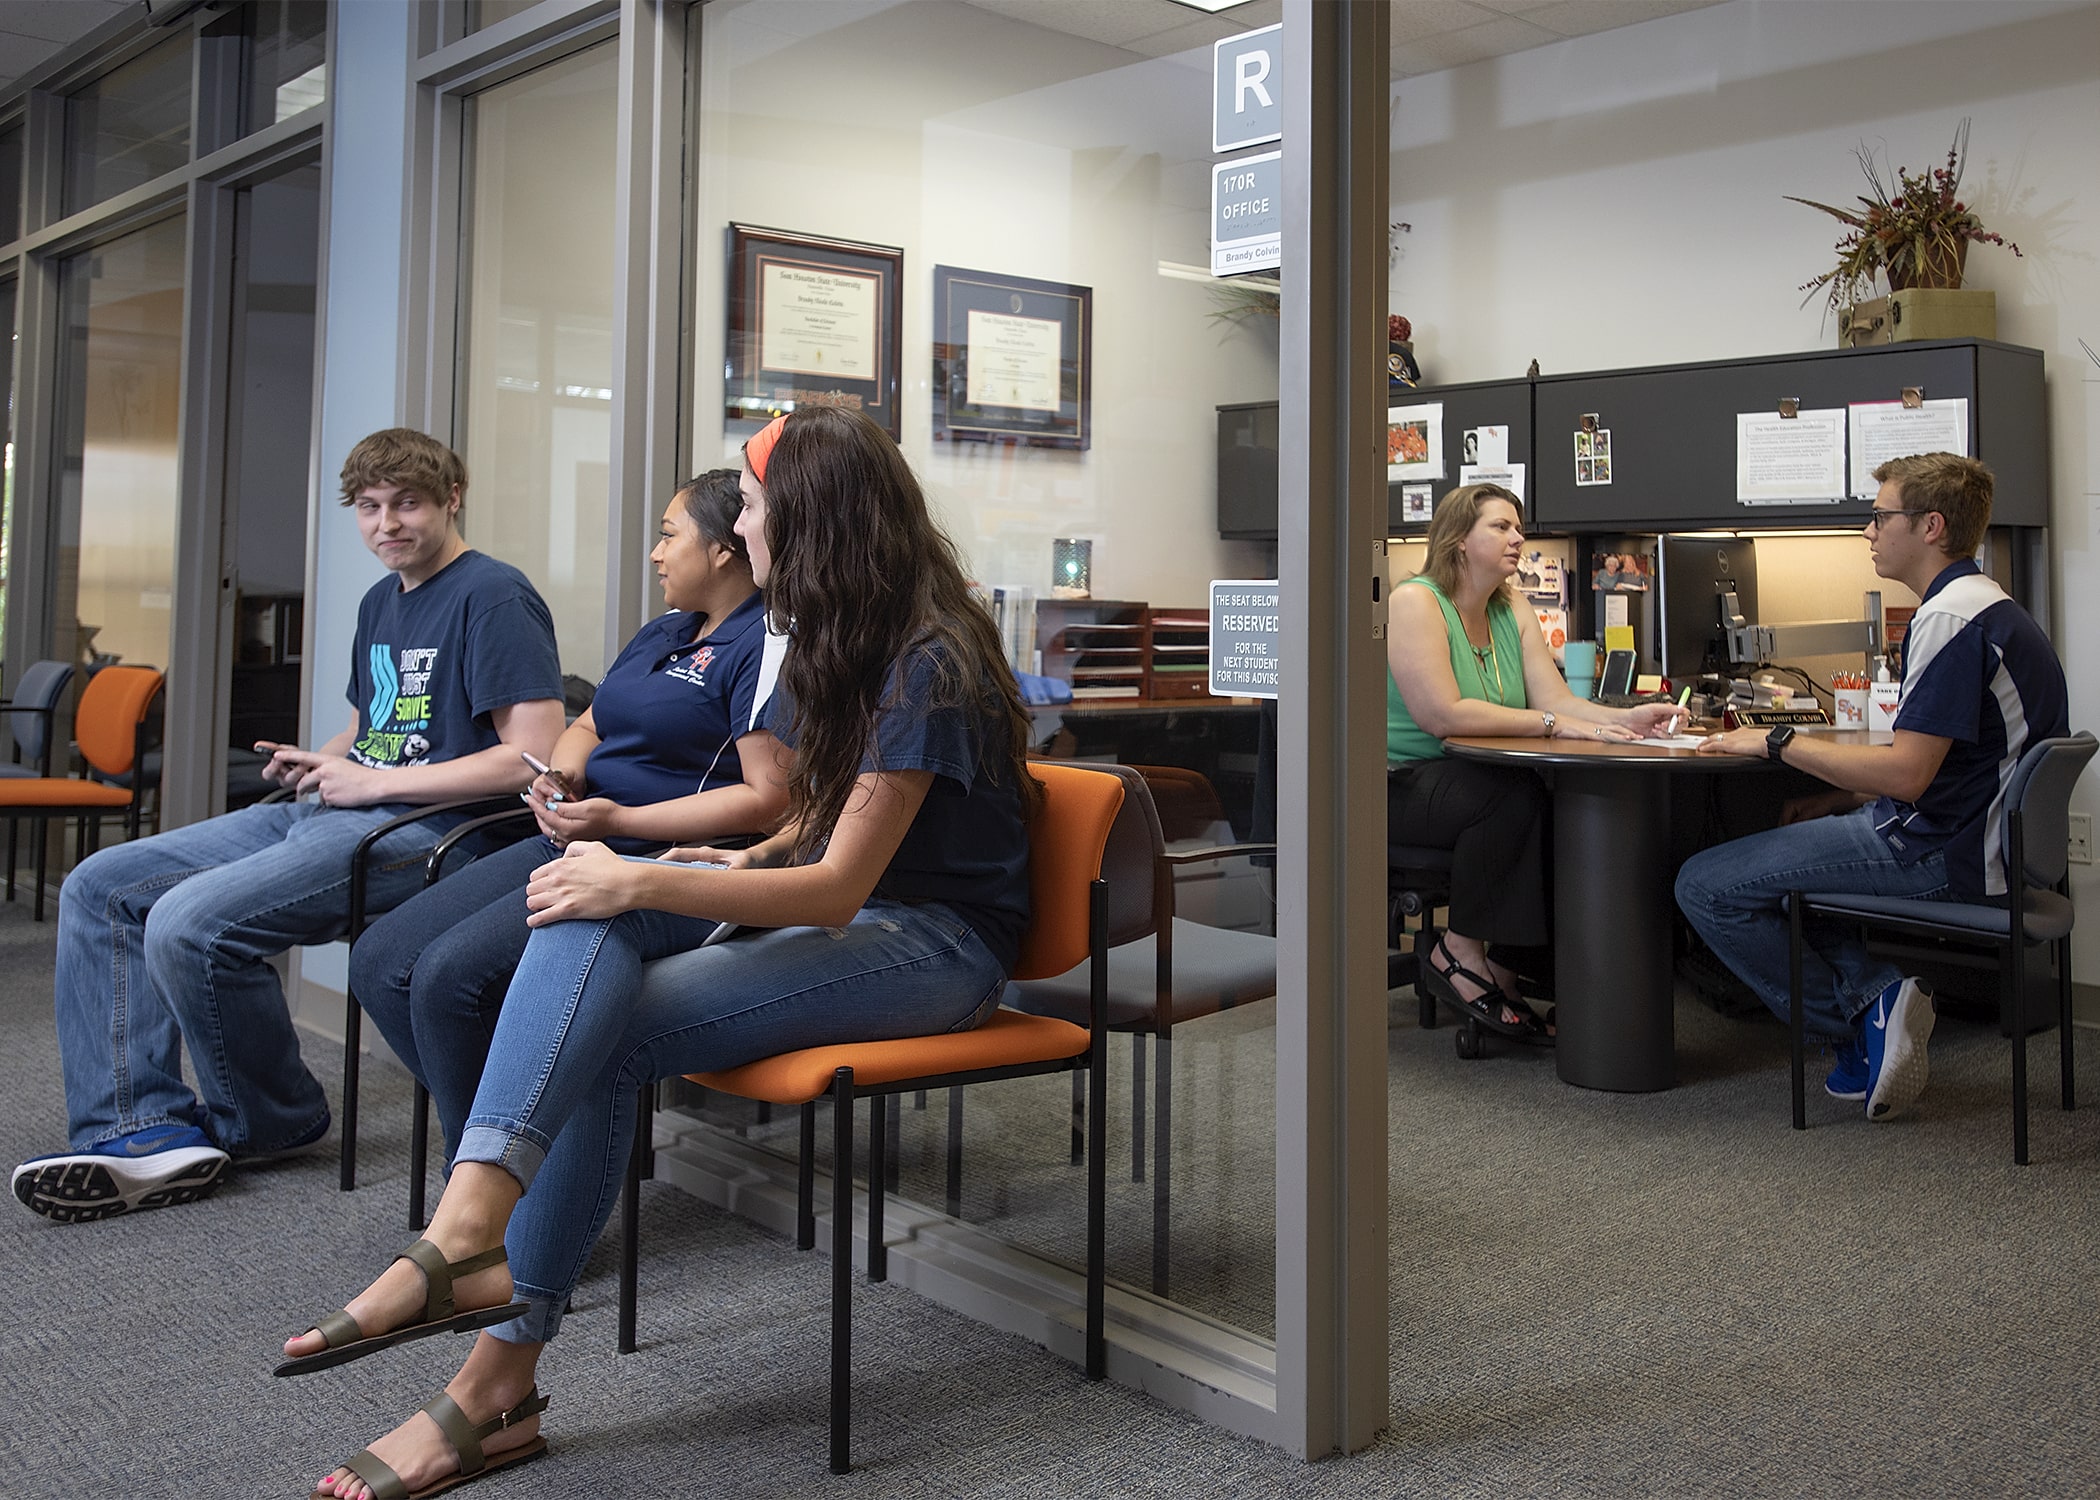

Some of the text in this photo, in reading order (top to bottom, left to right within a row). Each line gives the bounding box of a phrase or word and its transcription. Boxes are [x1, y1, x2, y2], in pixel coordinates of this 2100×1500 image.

[1235, 50, 1274, 114] R
[1223, 172, 1255, 194] 170R
[1223, 198, 1269, 220] OFFICE
[1226, 246, 1280, 262] Brandy Colvin
[1216, 594, 1279, 607] THE SEAT BELOW
[1222, 614, 1279, 632] RESERVED
[1235, 642, 1267, 655] FOR THE
[1223, 656, 1279, 670] NEXT STUDENT
[401, 672, 431, 696] JUST
[1216, 670, 1232, 682] FOR
[1233, 671, 1250, 683] THIS
[1761, 714, 1792, 724] BRANDY
[1792, 713, 1823, 724] COLVIN
